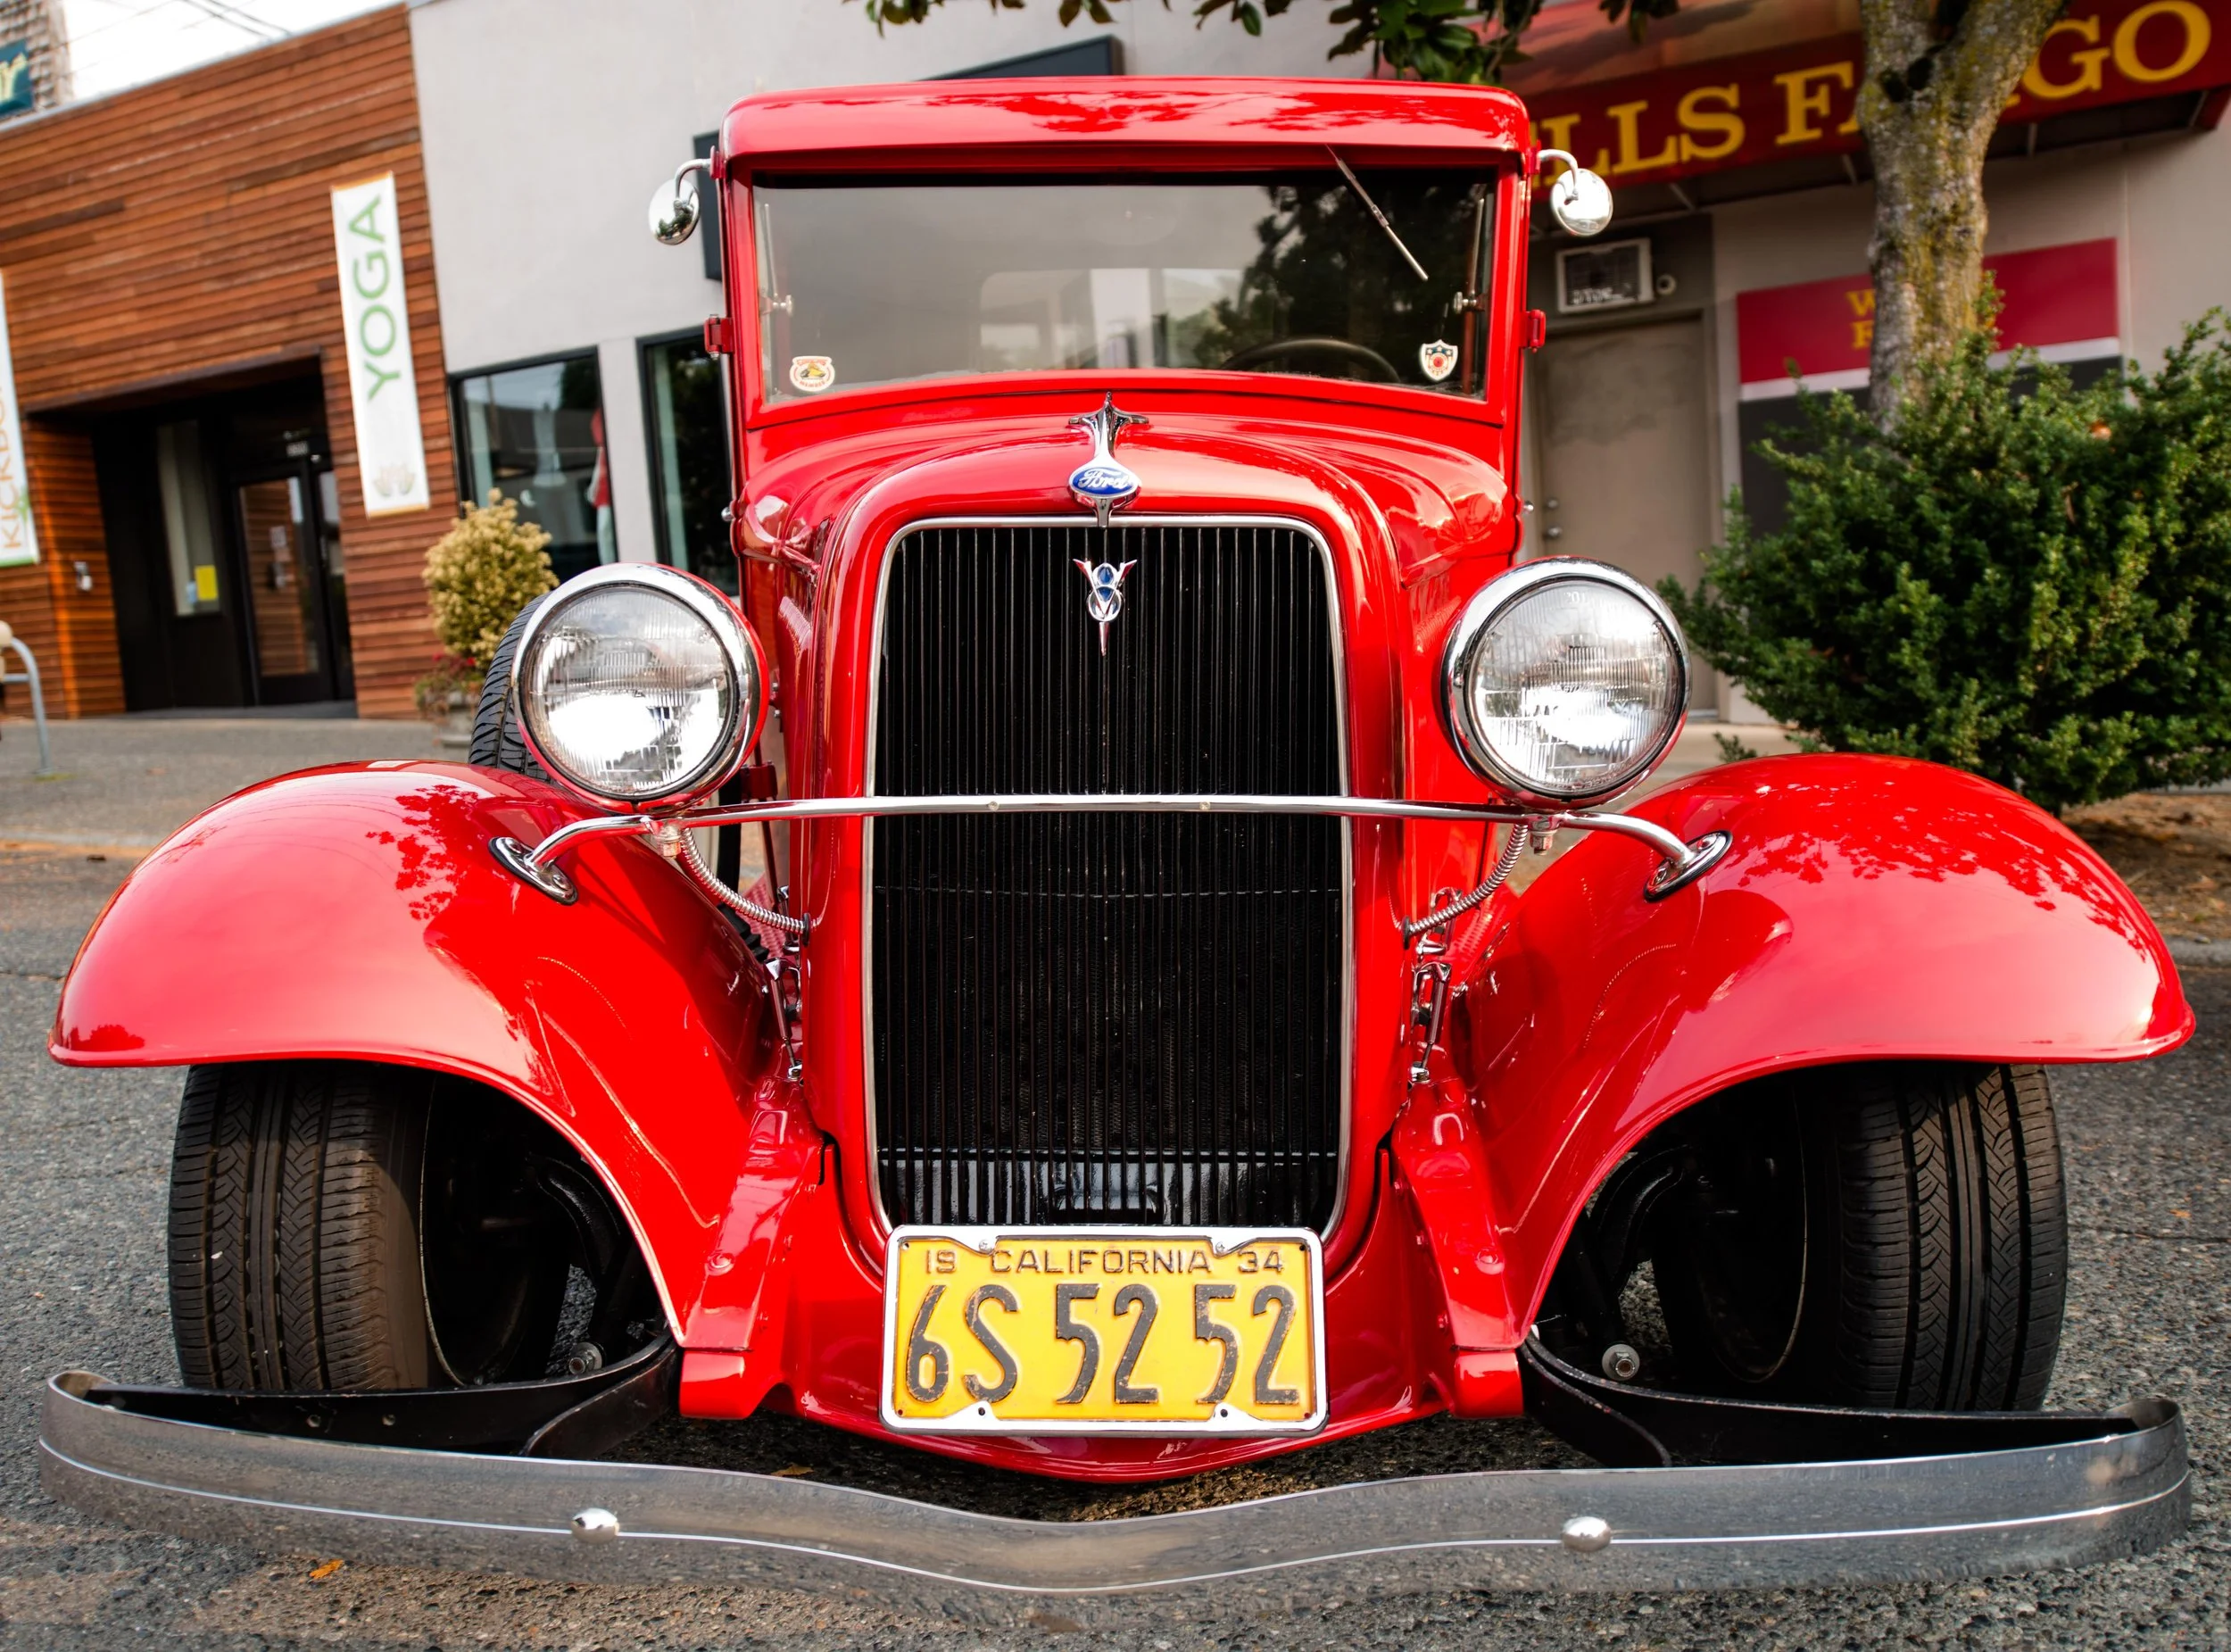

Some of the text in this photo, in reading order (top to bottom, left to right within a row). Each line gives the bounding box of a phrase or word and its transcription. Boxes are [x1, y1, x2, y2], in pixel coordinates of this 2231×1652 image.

[1529, 0, 2211, 189] LLS FGO
[348, 194, 402, 401] YOGA
[0, 390, 21, 548] KICKB
[1077, 469, 1130, 489] Ford
[926, 1249, 1284, 1274] 19 CALIFORNIA 34
[905, 1283, 1300, 1406] 6S 52 52
